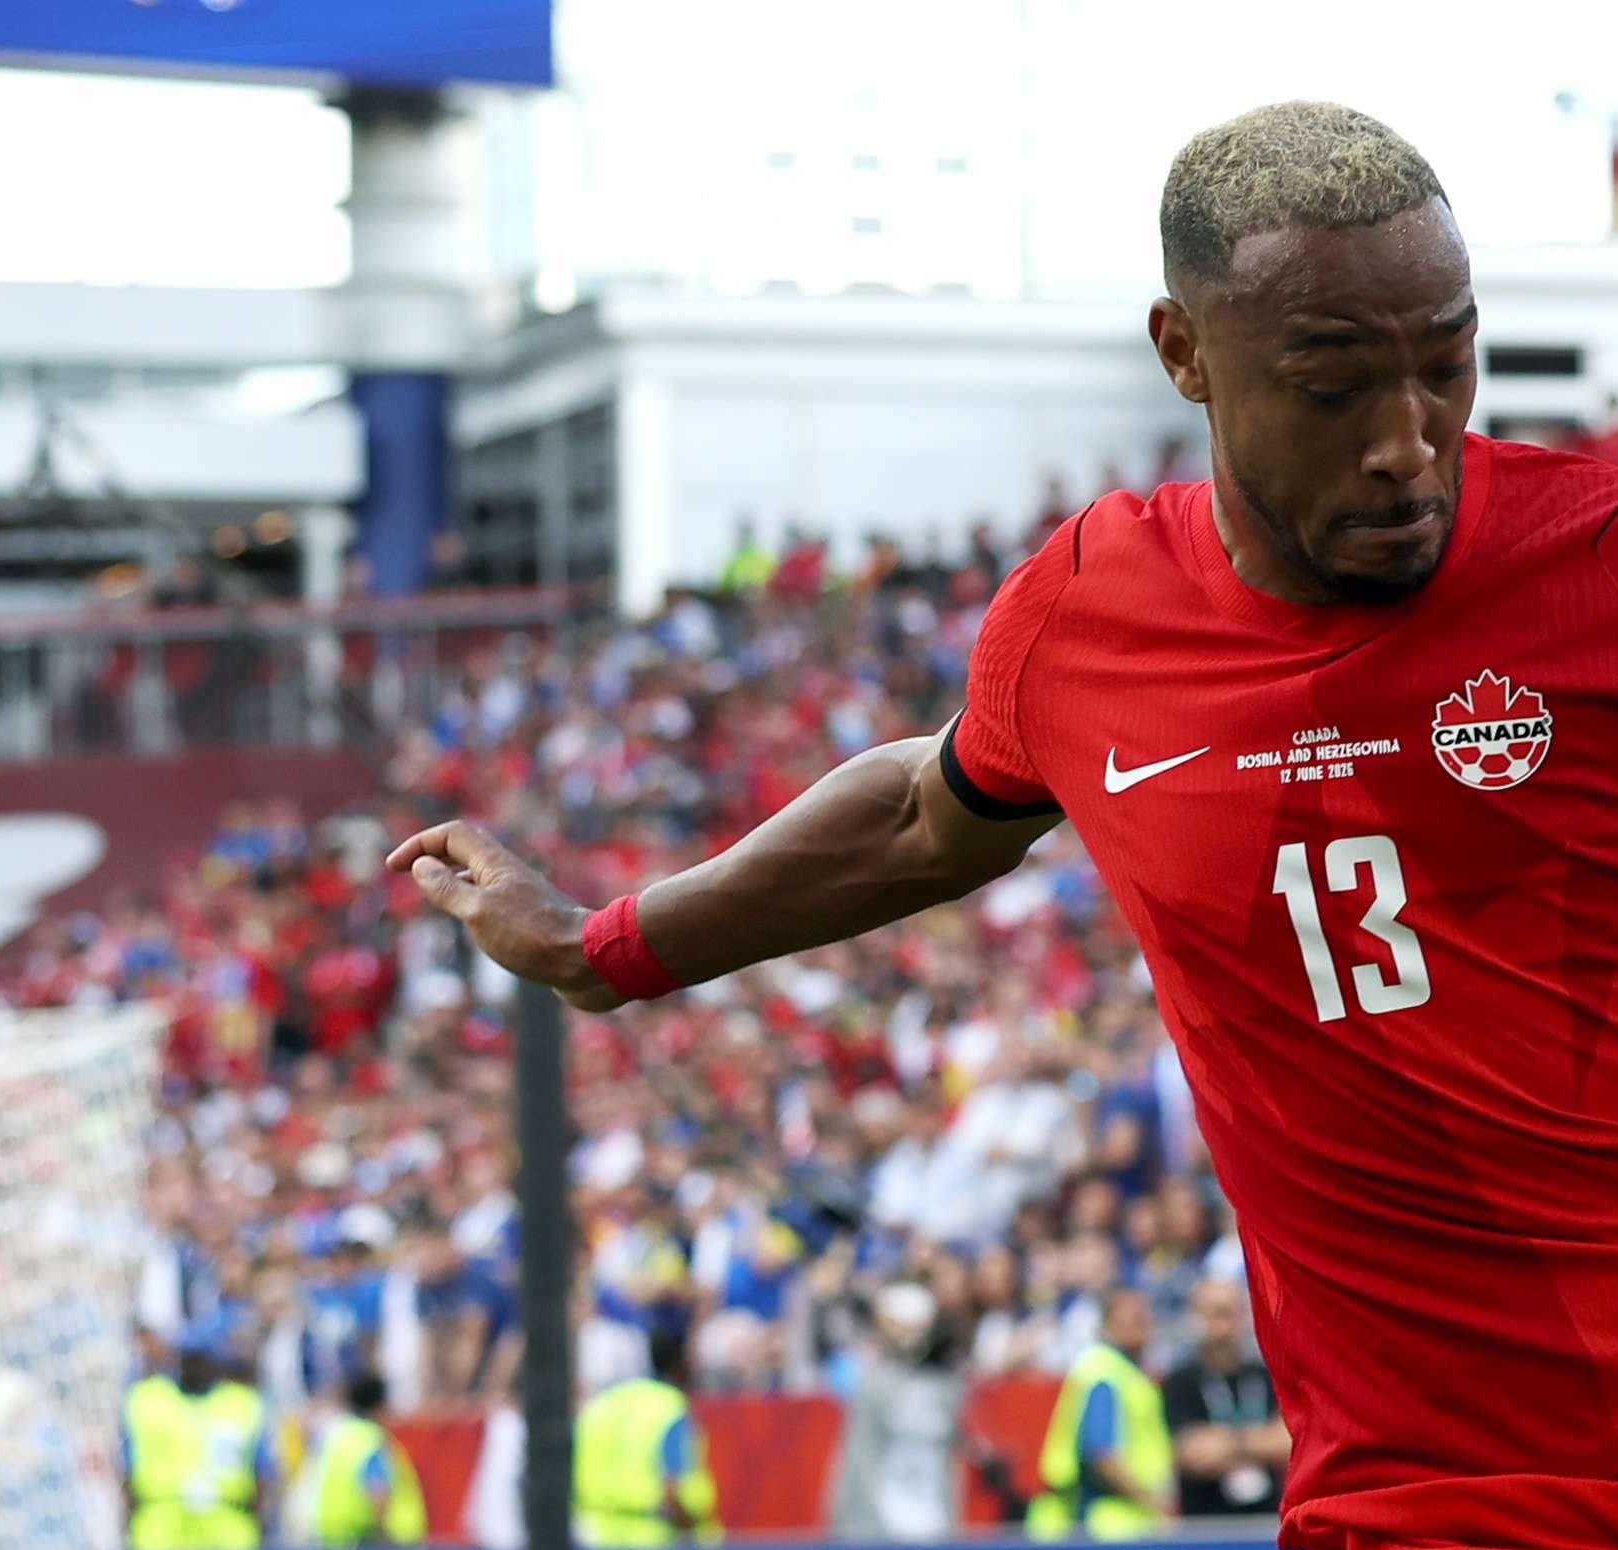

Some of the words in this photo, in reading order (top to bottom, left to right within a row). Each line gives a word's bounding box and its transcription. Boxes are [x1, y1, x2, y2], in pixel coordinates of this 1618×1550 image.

[1292, 725, 1341, 745] CANADA
[1434, 719, 1549, 747] CANADA
[1236, 750, 1283, 770] BOSNIA
[1286, 747, 1312, 764] AND
[1315, 738, 1401, 761] HERZEGOVINA
[1279, 767, 1292, 784] 12
[1295, 765, 1324, 782] JUNE
[1327, 762, 1355, 779] 2026
[1272, 834, 1432, 1024] 13
